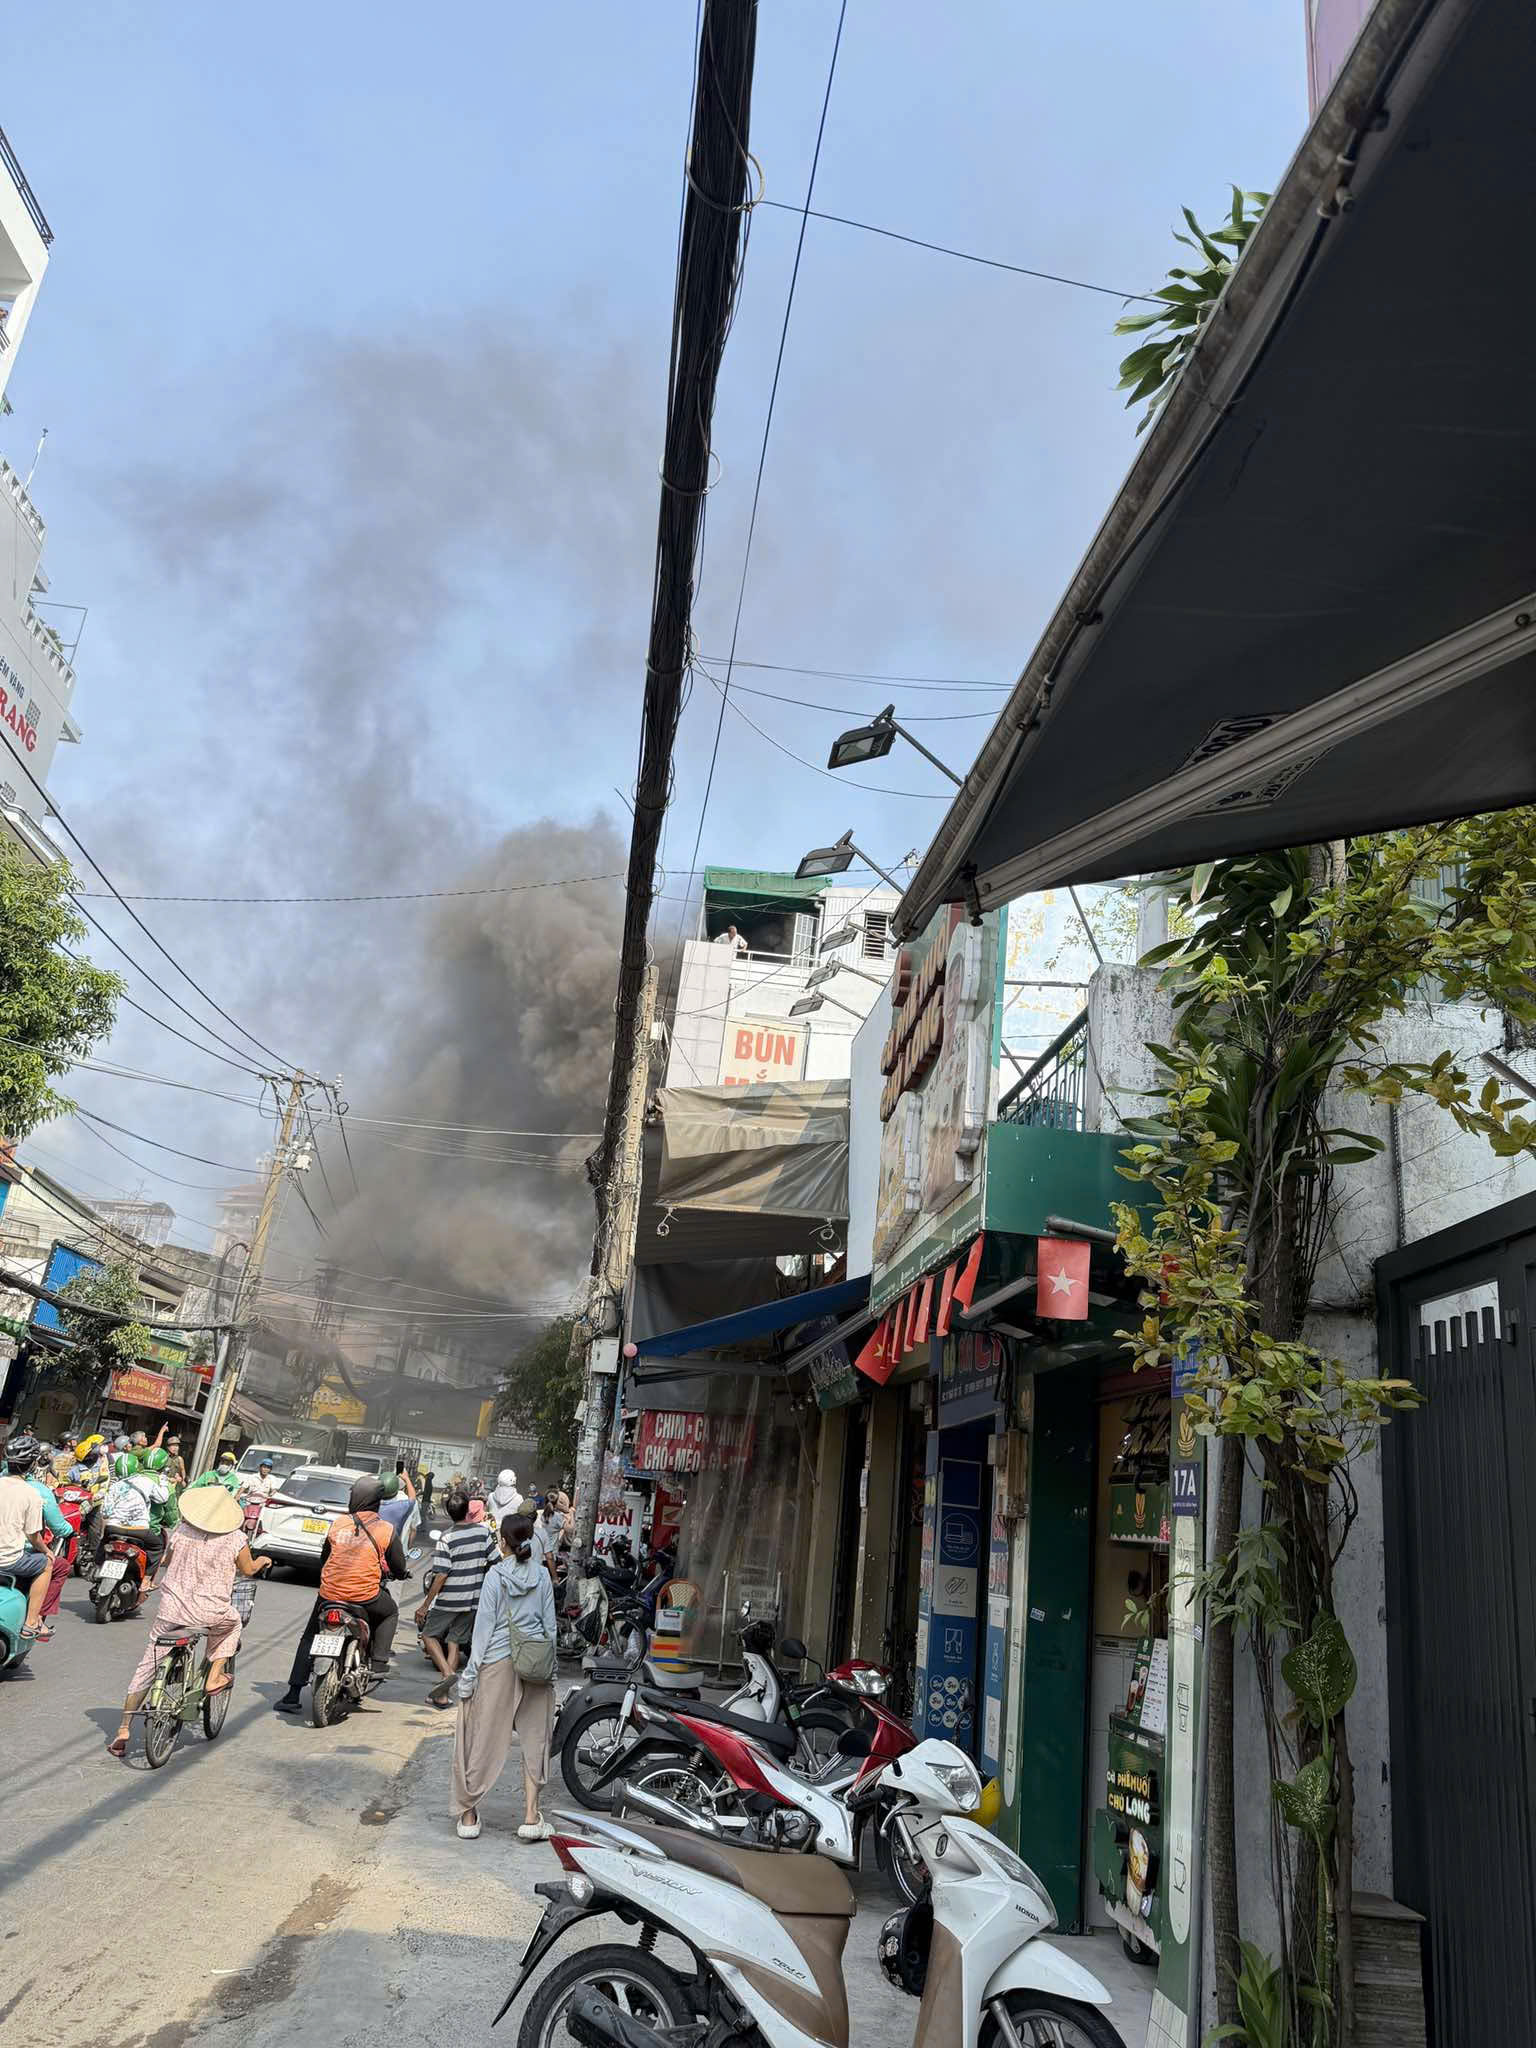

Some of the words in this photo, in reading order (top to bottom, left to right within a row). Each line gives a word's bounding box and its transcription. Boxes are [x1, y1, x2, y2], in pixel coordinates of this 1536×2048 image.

[9, 673, 25, 699] VÀNG
[734, 1026, 796, 1066] BÚN
[1173, 1469, 1197, 1497] 17A
[1116, 1769, 1131, 1788] PHÊ
[1125, 1795, 1151, 1825] LONG
[1015, 1904, 1040, 1923] HONDA
